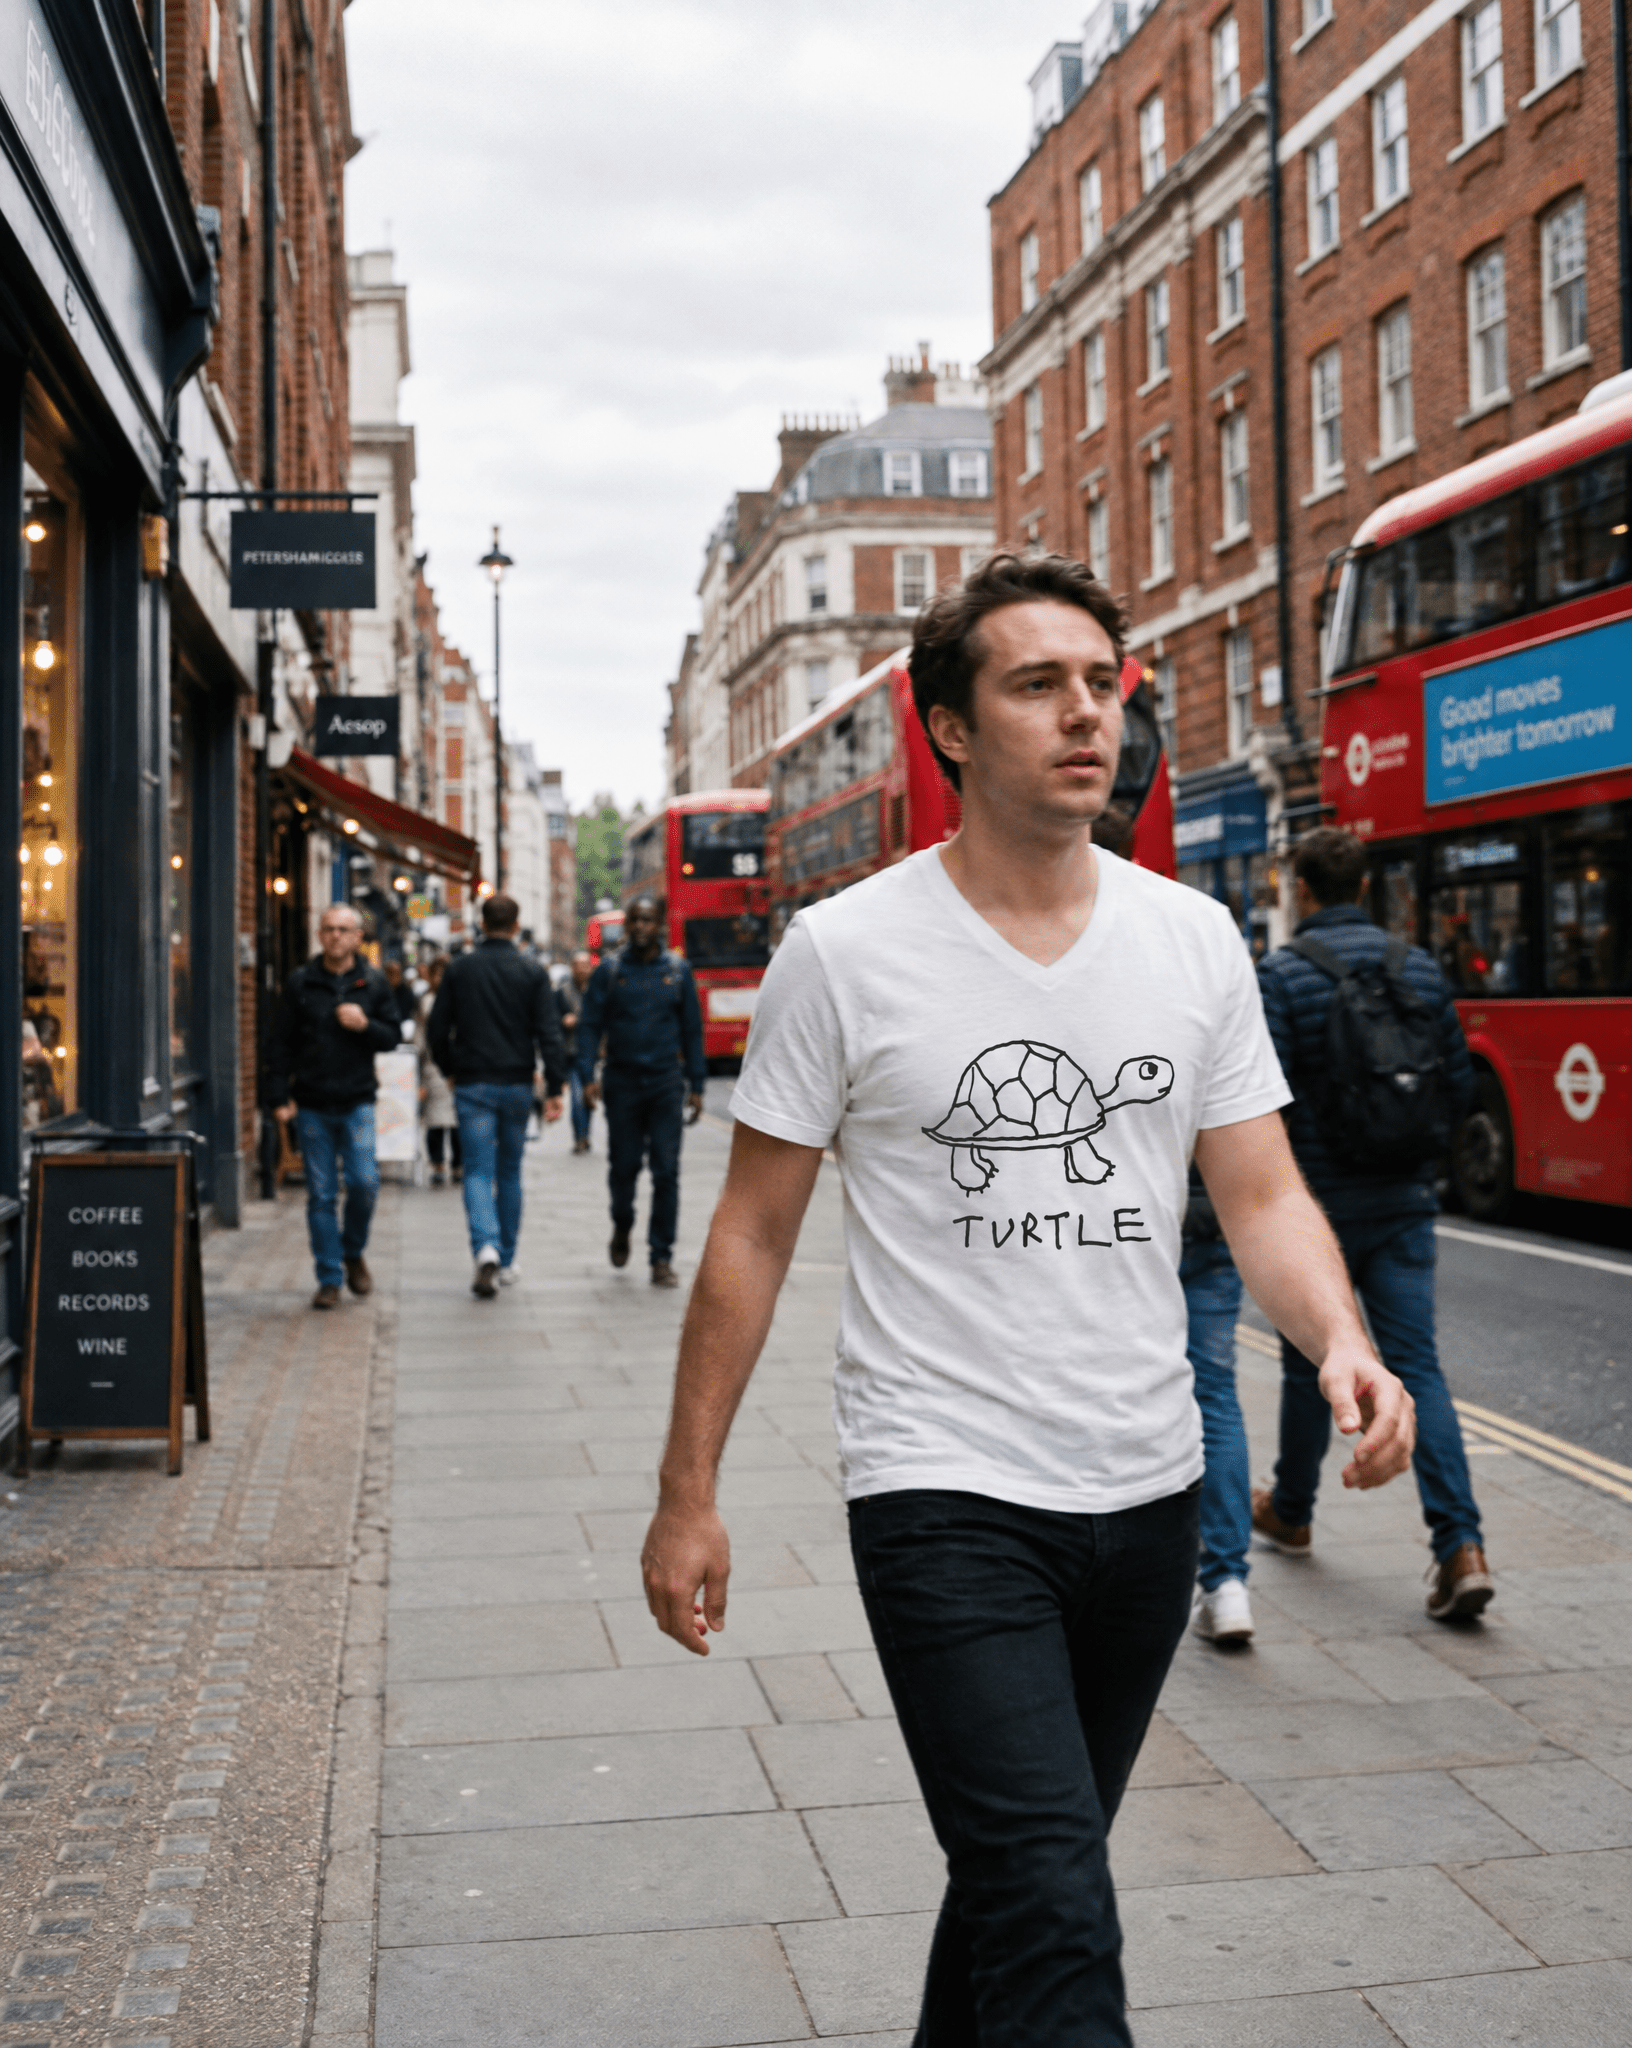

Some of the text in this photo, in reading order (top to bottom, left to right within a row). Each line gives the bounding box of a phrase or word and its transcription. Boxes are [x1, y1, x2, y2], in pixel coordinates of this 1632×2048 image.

[328, 714, 387, 739] Aesop
[1516, 704, 1616, 751] tomorrow
[68, 1206, 143, 1225] COFFEE
[952, 1207, 1152, 1250] TURTLE
[71, 1249, 139, 1268] BOOKS
[58, 1293, 150, 1312] RECORDS
[77, 1337, 128, 1356] WINE
